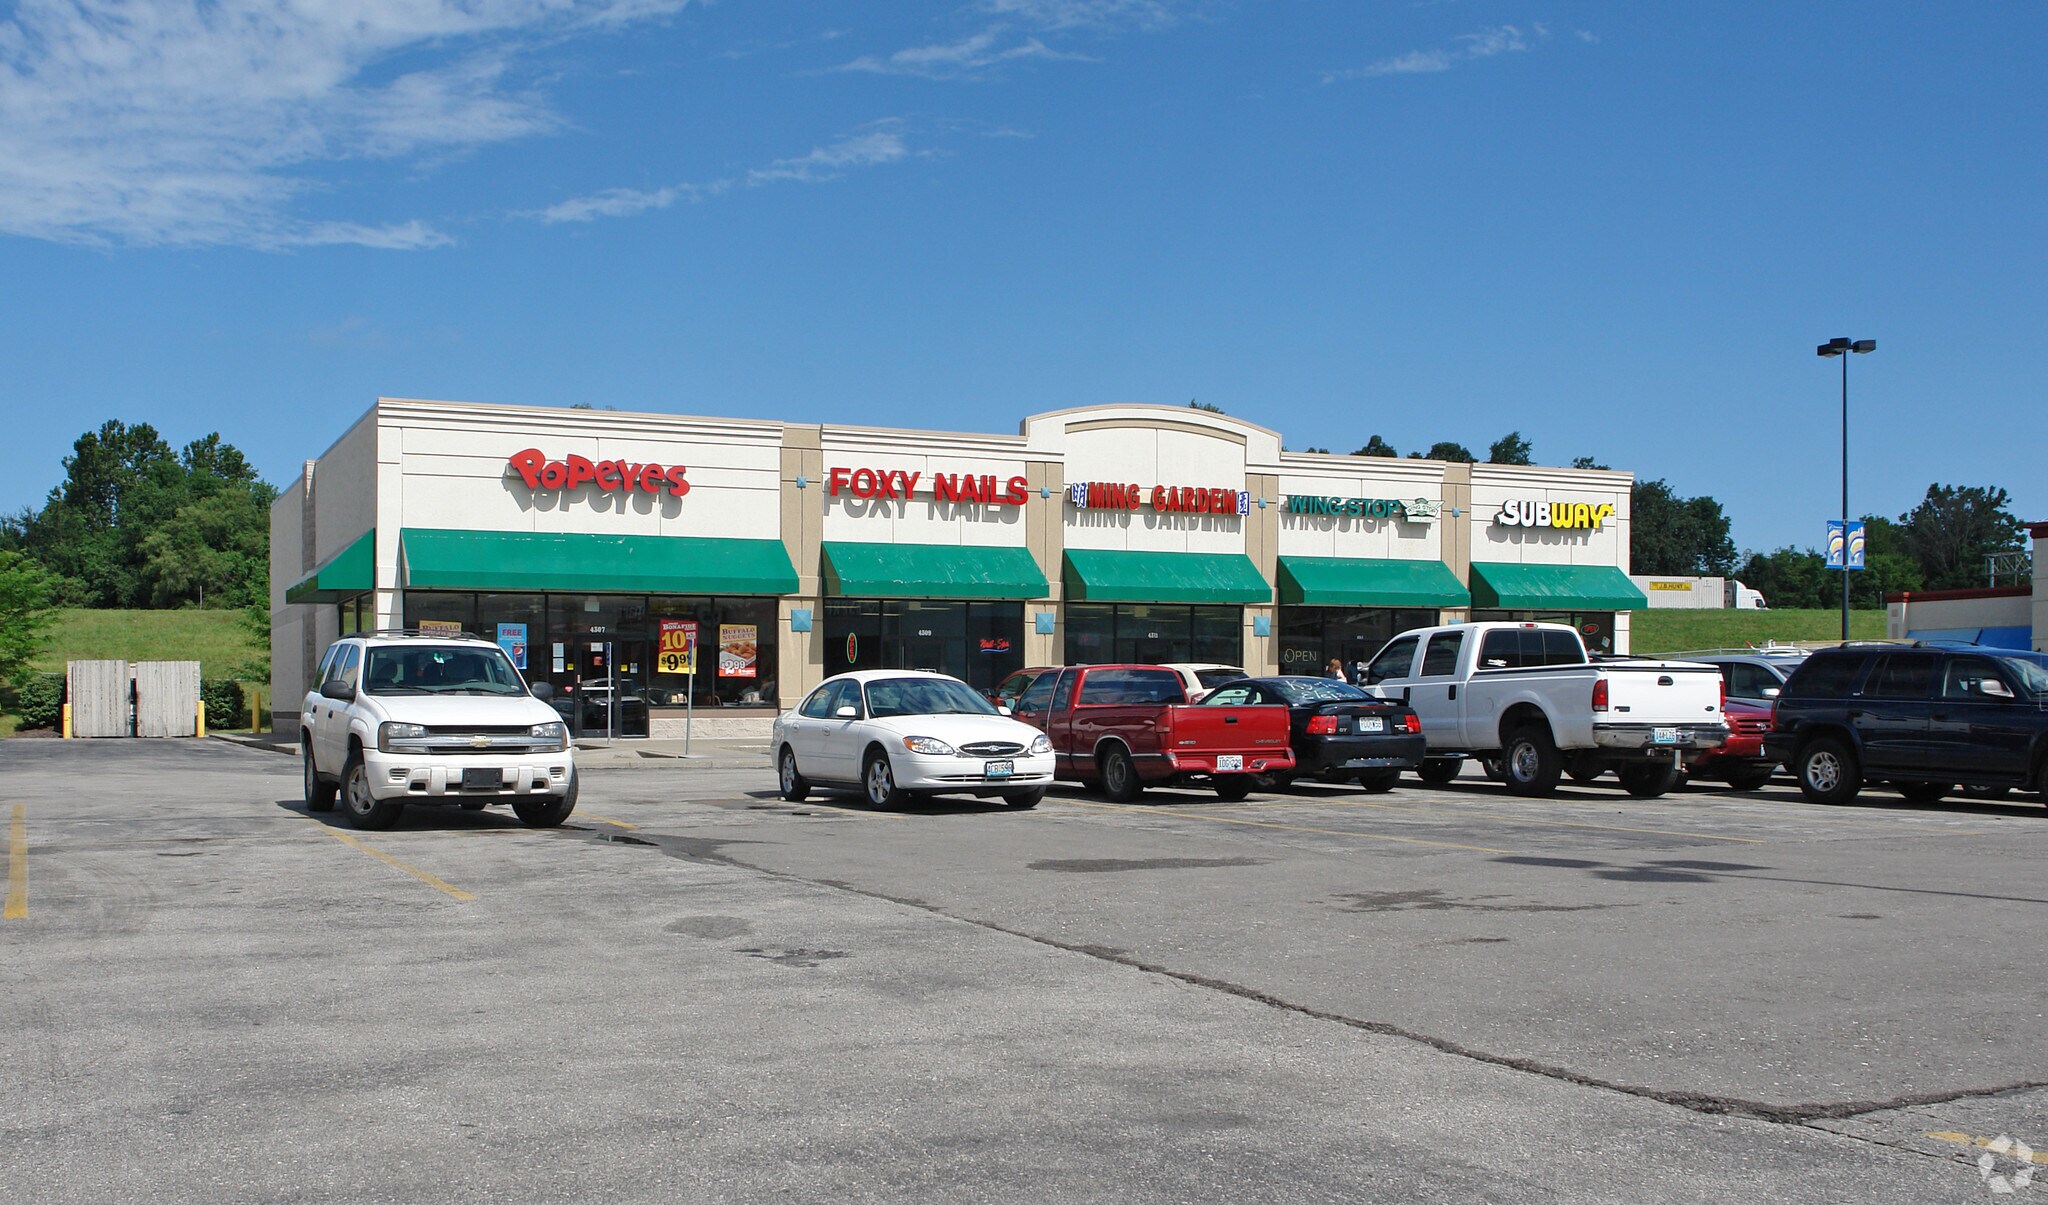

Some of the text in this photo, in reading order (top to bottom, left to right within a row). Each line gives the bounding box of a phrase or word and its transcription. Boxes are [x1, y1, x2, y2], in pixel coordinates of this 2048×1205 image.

[829, 467, 1029, 506] FOXY NAILS
[1088, 482, 1236, 515] MING GARDEN
[1498, 499, 1615, 529] SUBWAY
[662, 630, 686, 650] 10
[722, 627, 755, 635] BUFFALO
[1284, 648, 1317, 663] OPEN
